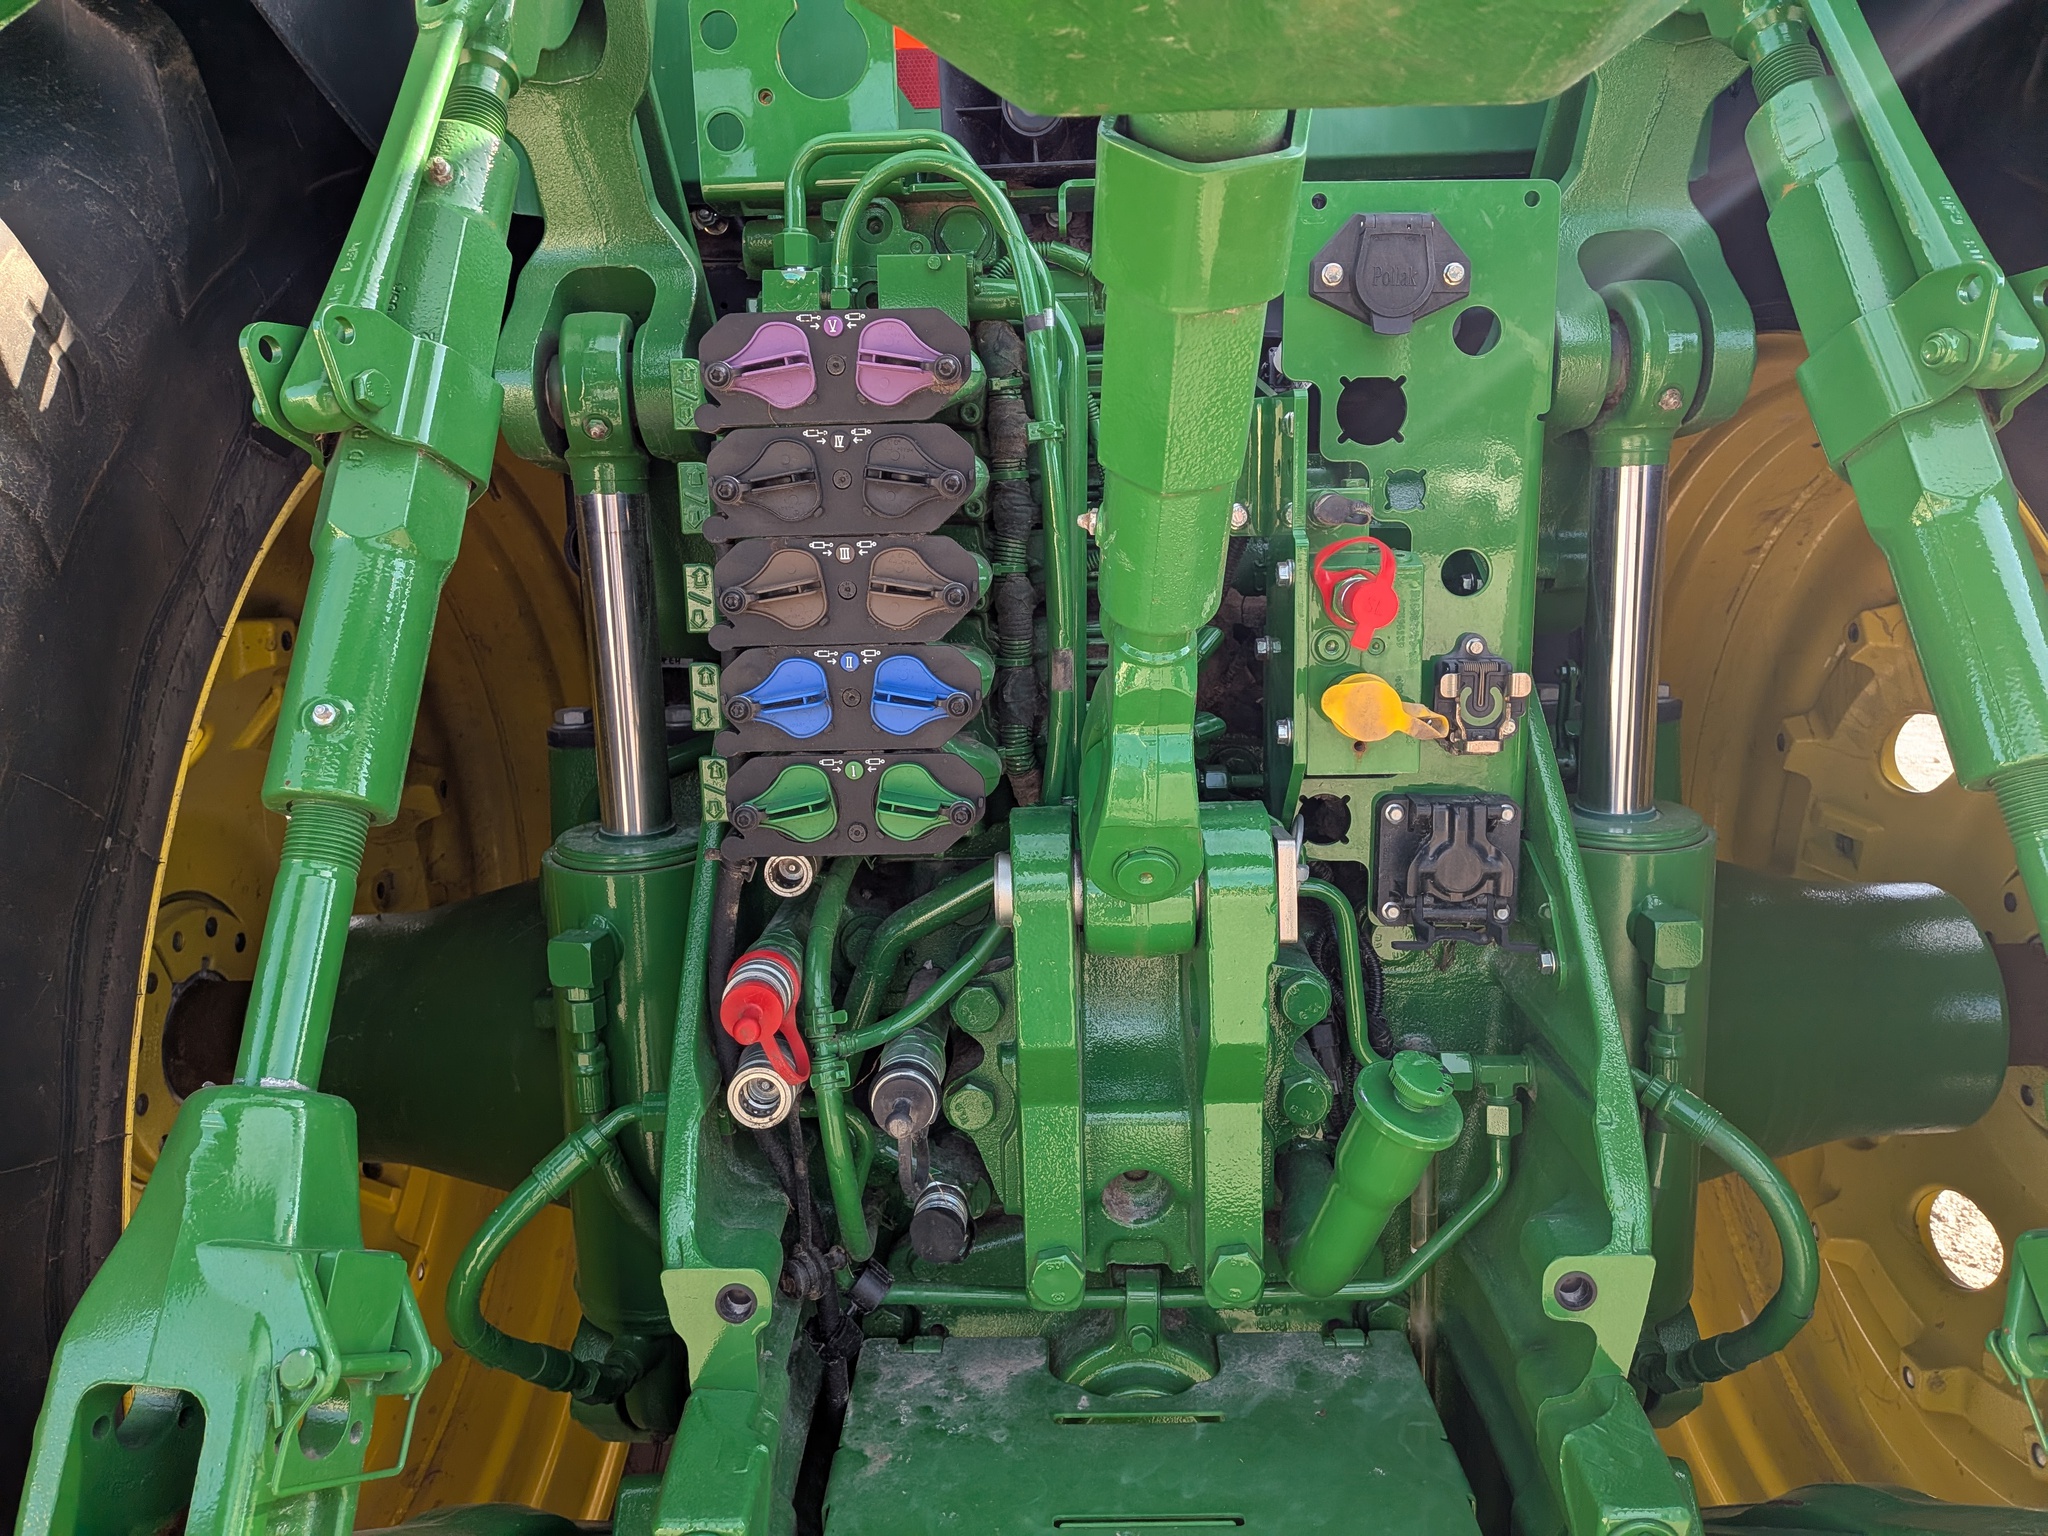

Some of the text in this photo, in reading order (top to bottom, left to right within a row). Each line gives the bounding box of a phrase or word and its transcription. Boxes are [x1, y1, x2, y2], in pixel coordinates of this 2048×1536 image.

[1372, 265, 1418, 287] Pollak
[827, 319, 837, 333] V
[834, 435, 844, 448] IV
[839, 547, 850, 560] III
[846, 656, 853, 669] II
[851, 765, 856, 777] I
